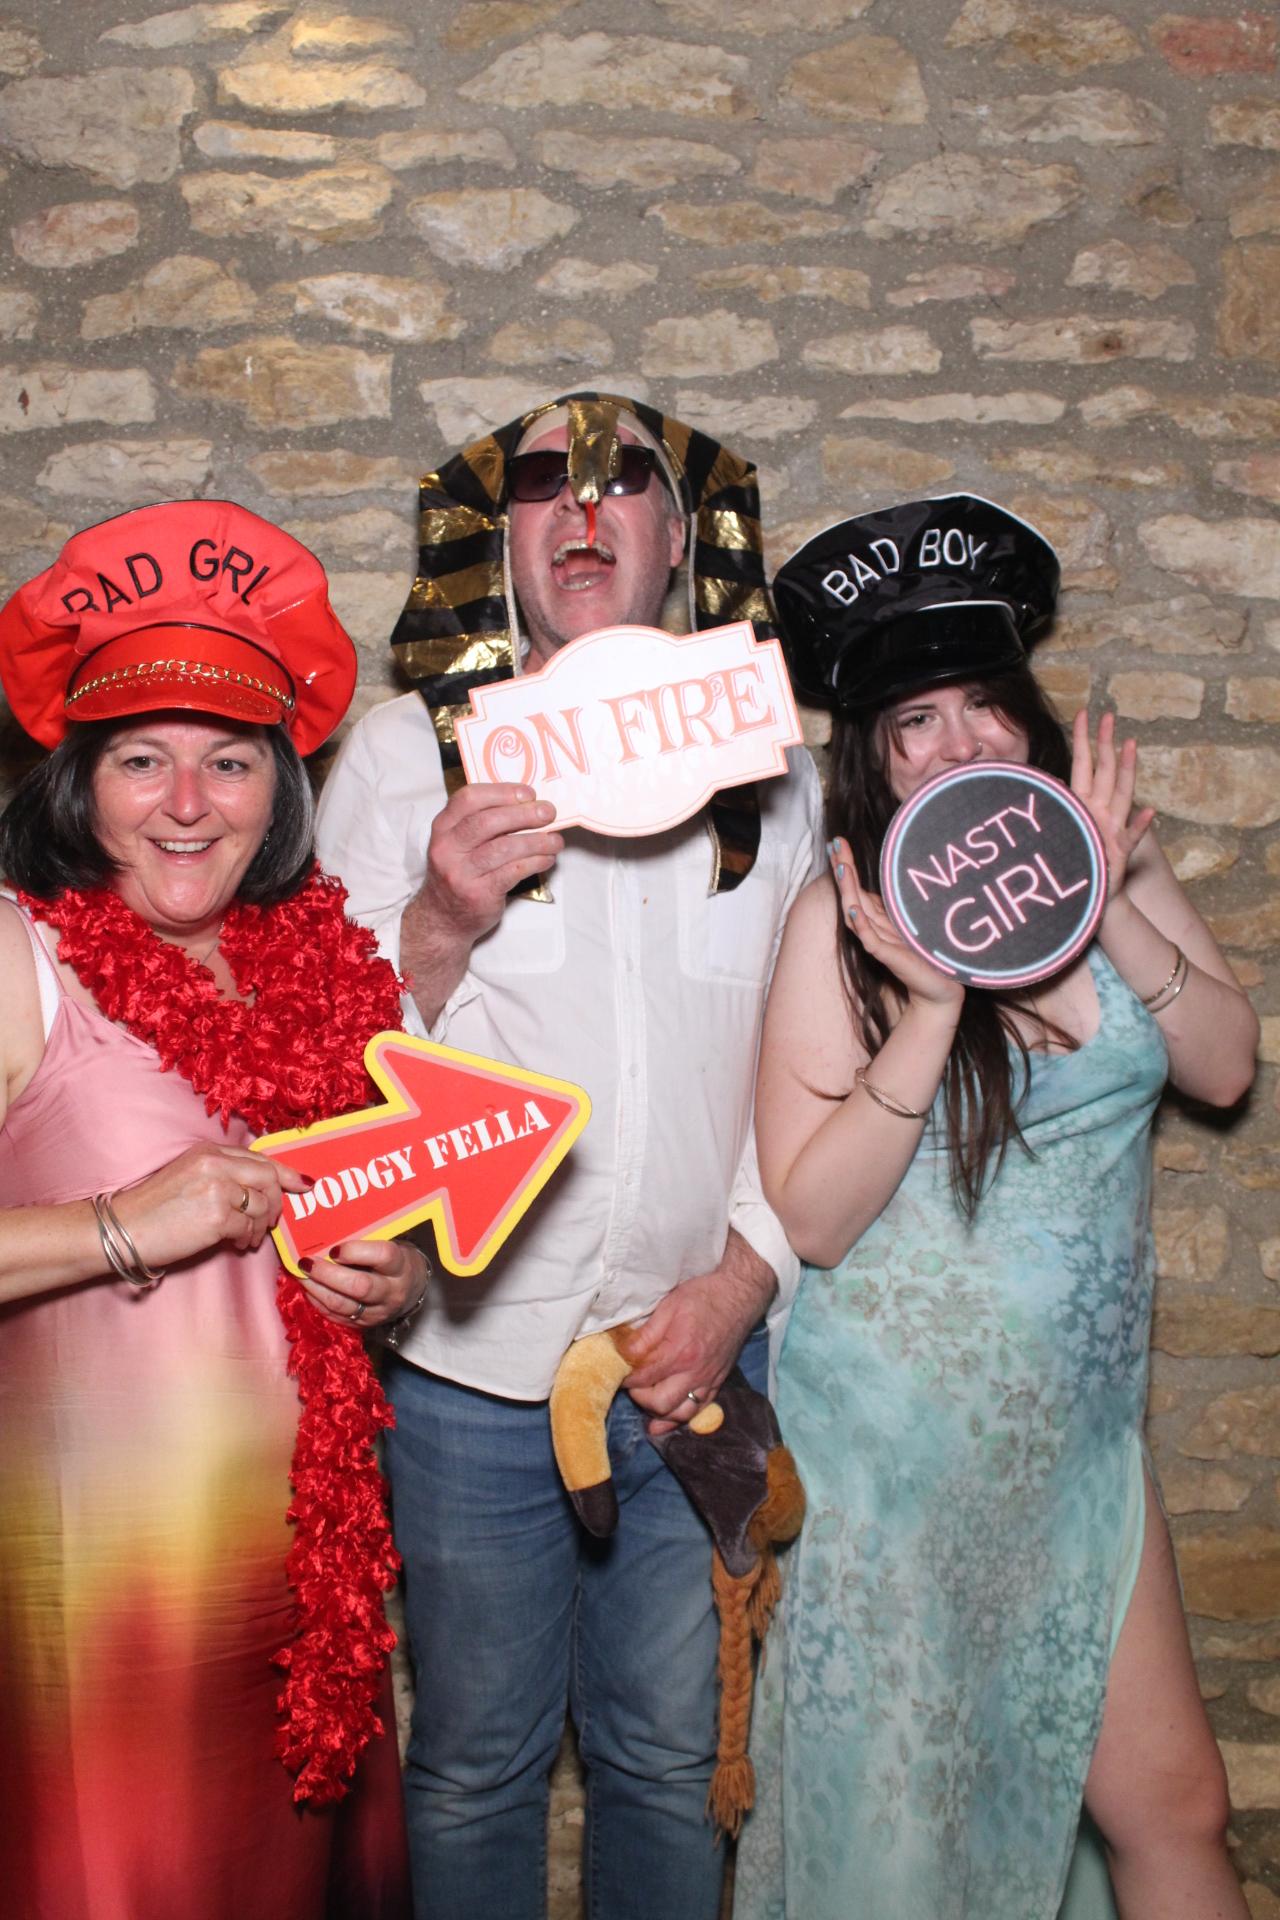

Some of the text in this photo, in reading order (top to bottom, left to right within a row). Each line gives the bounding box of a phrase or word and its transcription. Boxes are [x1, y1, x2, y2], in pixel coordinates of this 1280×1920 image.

[821, 528, 988, 606] BAD BOY
[483, 662, 777, 786] ON FIRE
[907, 793, 1041, 901] NASTY
[944, 852, 1089, 952] GIRL
[284, 1100, 551, 1221] DODGY FELLA
